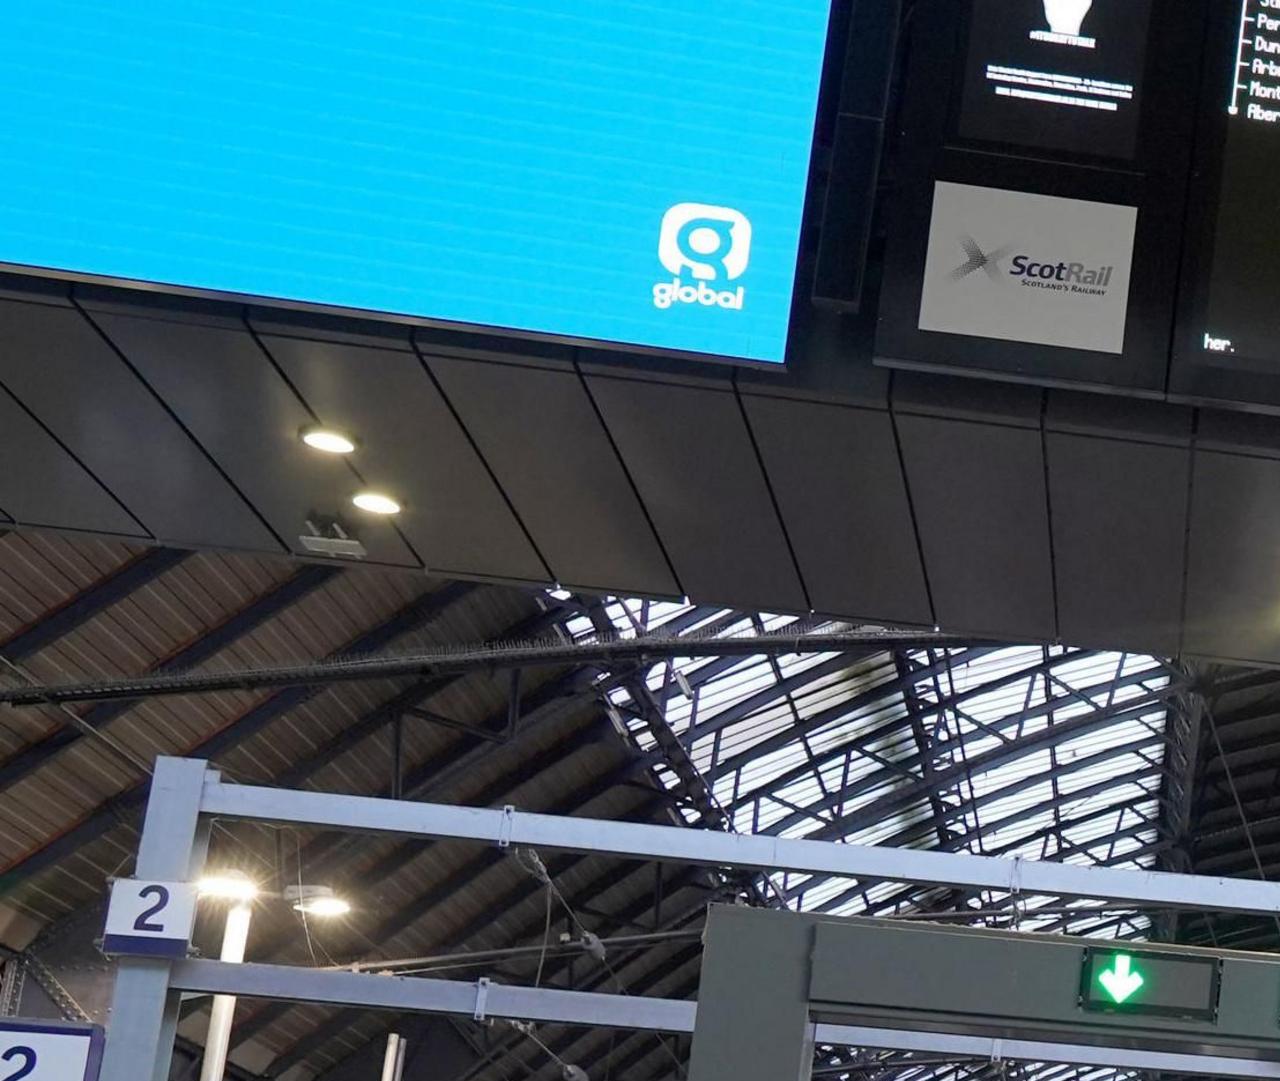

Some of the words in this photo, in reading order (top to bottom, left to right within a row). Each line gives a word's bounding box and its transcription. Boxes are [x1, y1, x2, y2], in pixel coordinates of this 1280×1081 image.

[1009, 254, 1115, 288] ScotRail
[652, 279, 744, 311] global
[132, 885, 169, 931] 2
